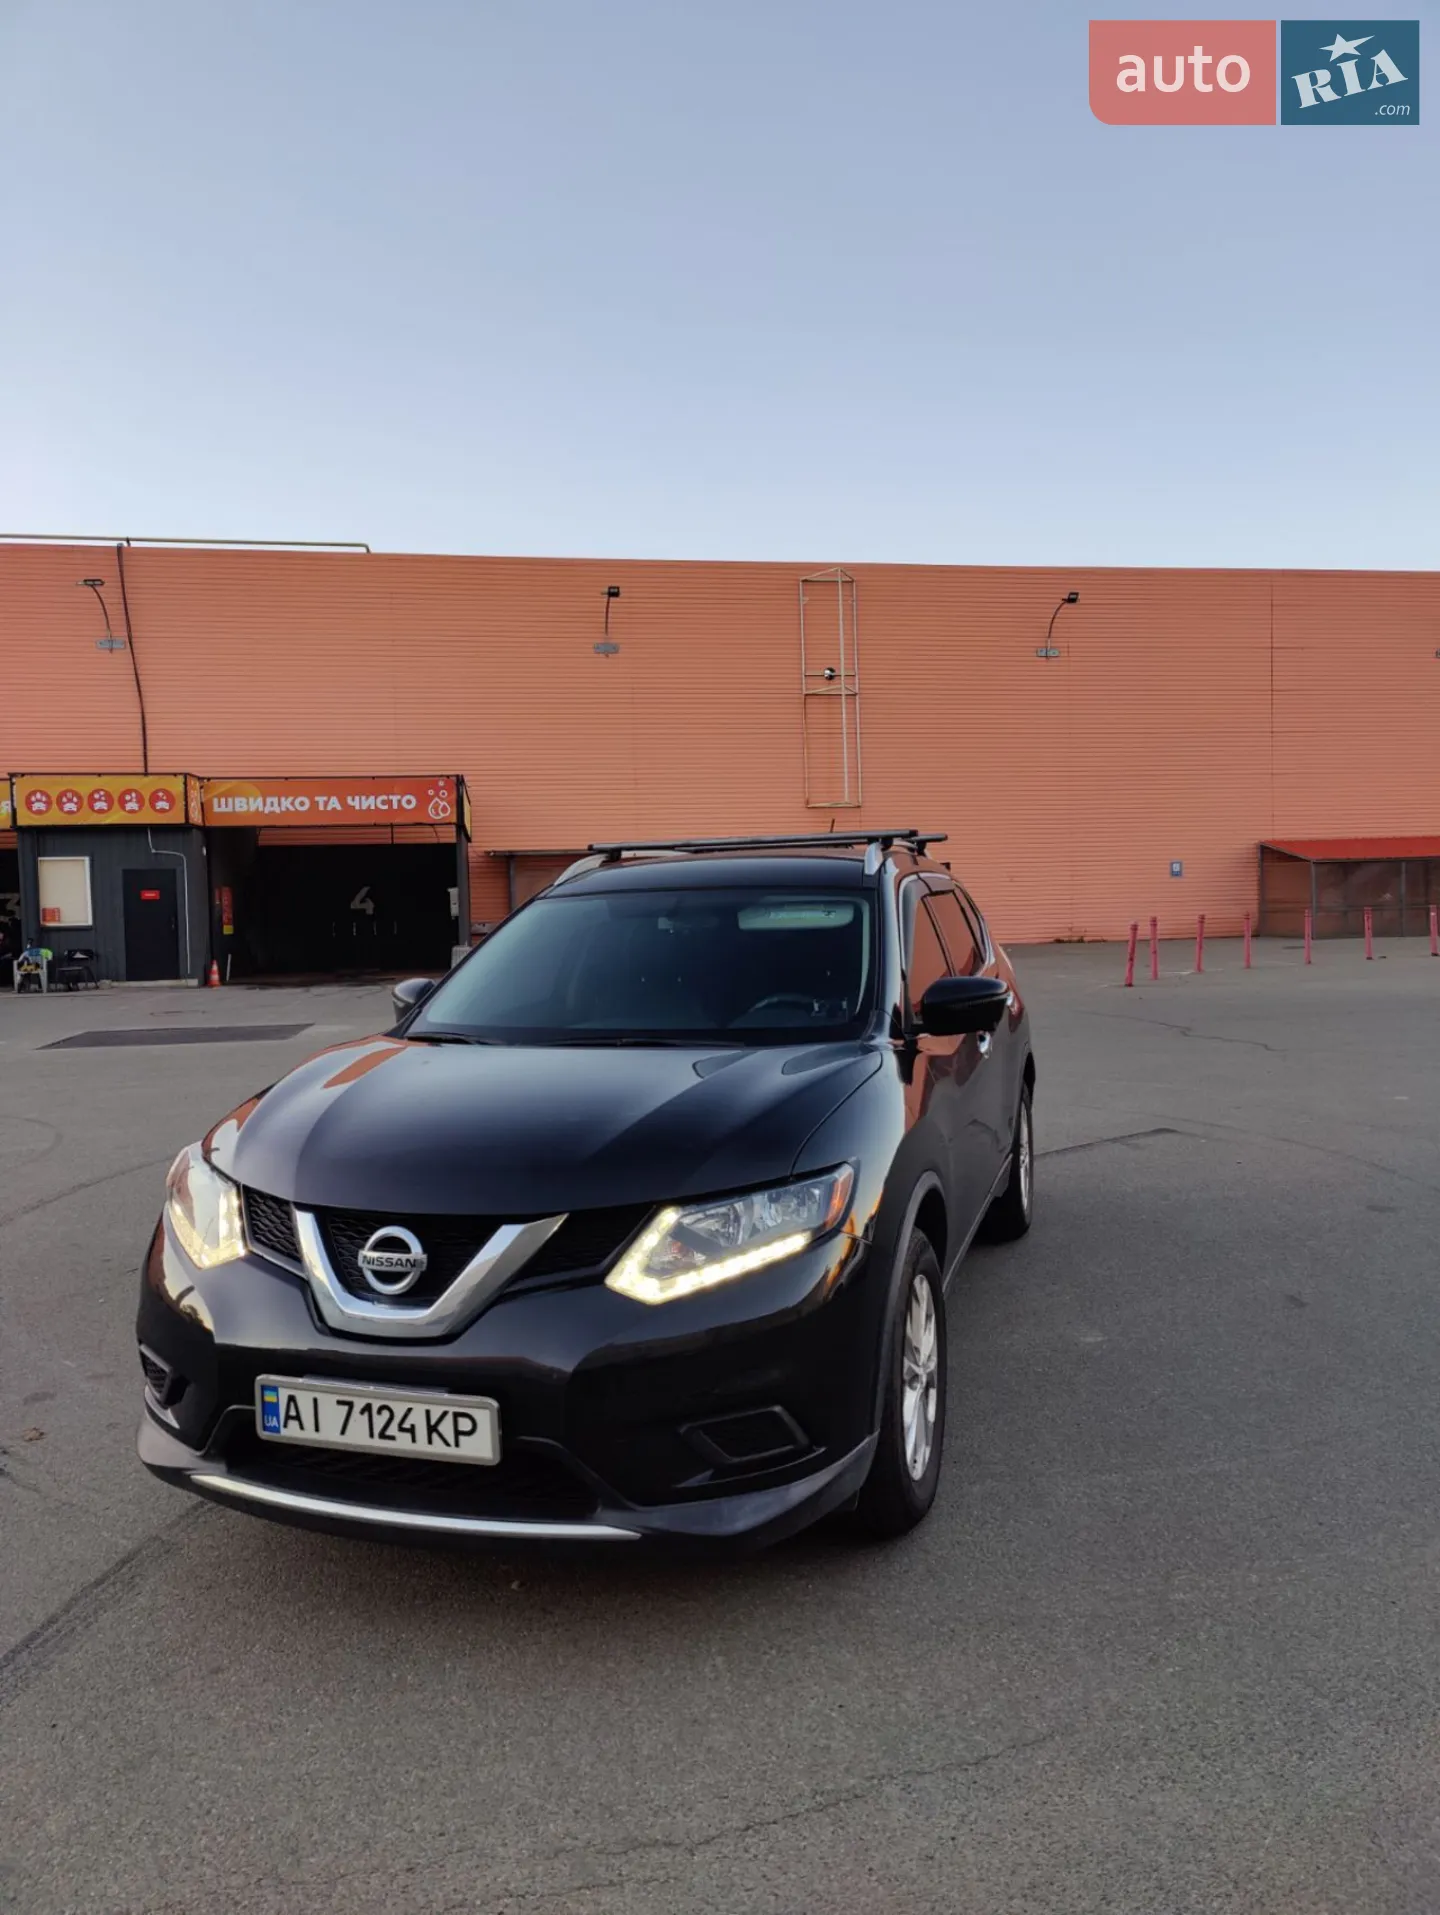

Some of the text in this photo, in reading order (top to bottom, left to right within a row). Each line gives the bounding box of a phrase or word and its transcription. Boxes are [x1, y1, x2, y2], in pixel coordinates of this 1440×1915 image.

[212, 794, 417, 814] ШВИДКО ТА ЧИСТО
[350, 886, 375, 915] 4
[361, 1255, 417, 1269] NISSAN
[264, 1414, 279, 1428] UA
[283, 1394, 478, 1448] AI 7124 KP
